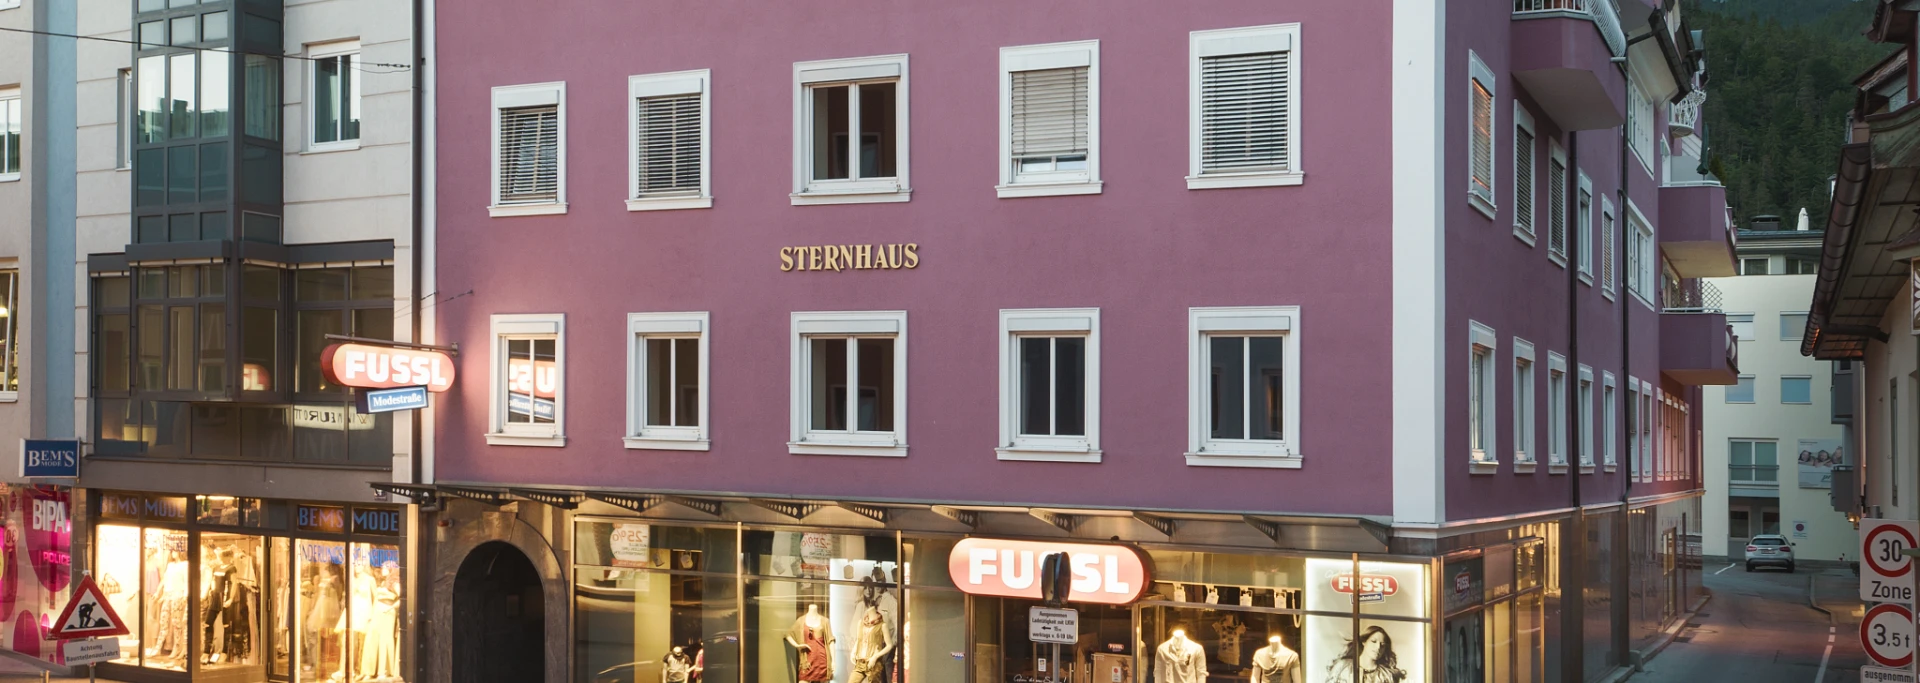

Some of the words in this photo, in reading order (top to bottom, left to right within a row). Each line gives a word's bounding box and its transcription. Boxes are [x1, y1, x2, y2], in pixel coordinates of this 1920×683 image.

[779, 242, 919, 273] STERNHAUS
[344, 350, 447, 387] FUSSL
[372, 392, 422, 407] Modestraße
[27, 450, 75, 467] BEM'S
[32, 499, 67, 534] BIPA
[299, 507, 345, 529] BEMS
[351, 510, 399, 532] MODE
[1879, 539, 1902, 562] 30
[968, 547, 1129, 594] FUSL
[1871, 580, 1912, 600] Zone
[80, 644, 103, 652] Achtung
